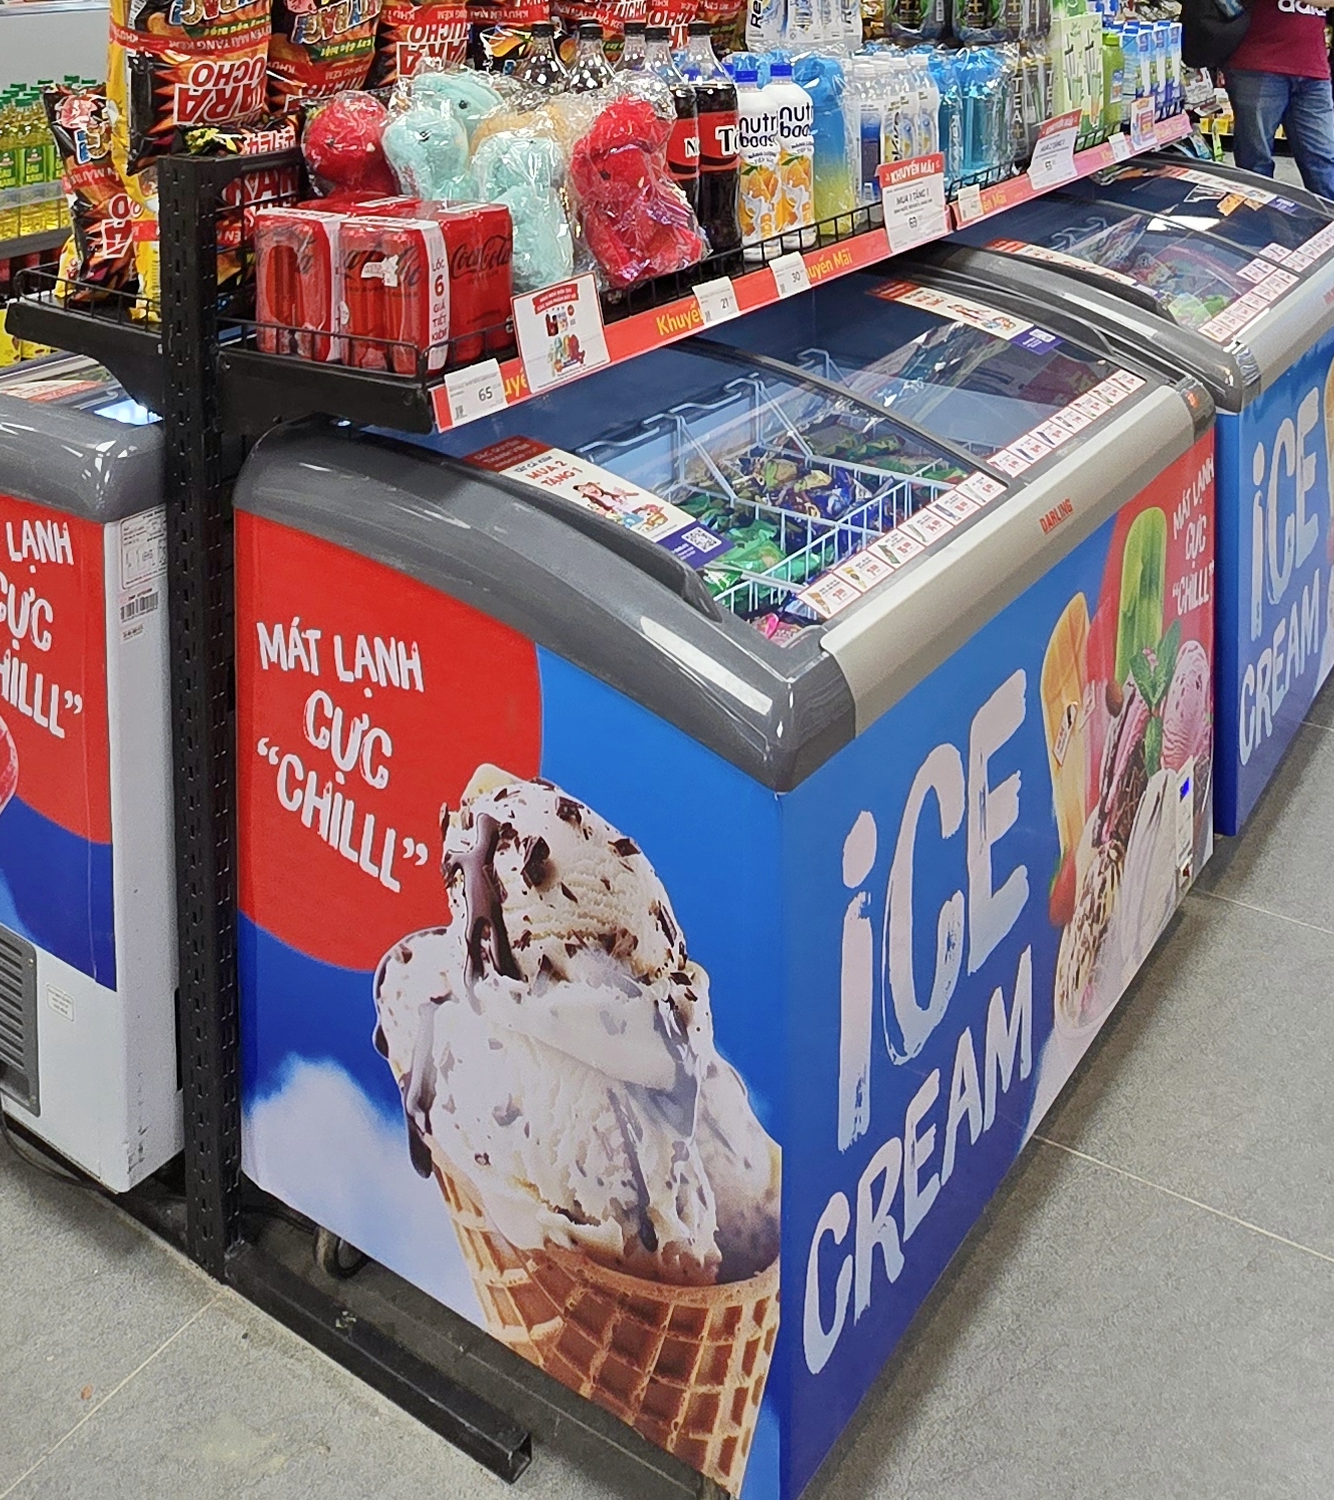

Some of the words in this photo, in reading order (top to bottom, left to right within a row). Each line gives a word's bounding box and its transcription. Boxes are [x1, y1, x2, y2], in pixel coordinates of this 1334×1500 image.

[434, 274, 444, 296] 6
[791, 271, 801, 284] 30
[721, 297, 730, 310] 21
[478, 386, 493, 400] 65
[1039, 498, 1073, 534] DARLING
[6, 519, 74, 573] LẠNH
[257, 616, 321, 671] MÁT
[334, 633, 425, 698] LẠNH
[1239, 568, 1320, 765] CREAM
[303, 689, 393, 790] CỰC
[804, 945, 1032, 1374] CREAM
